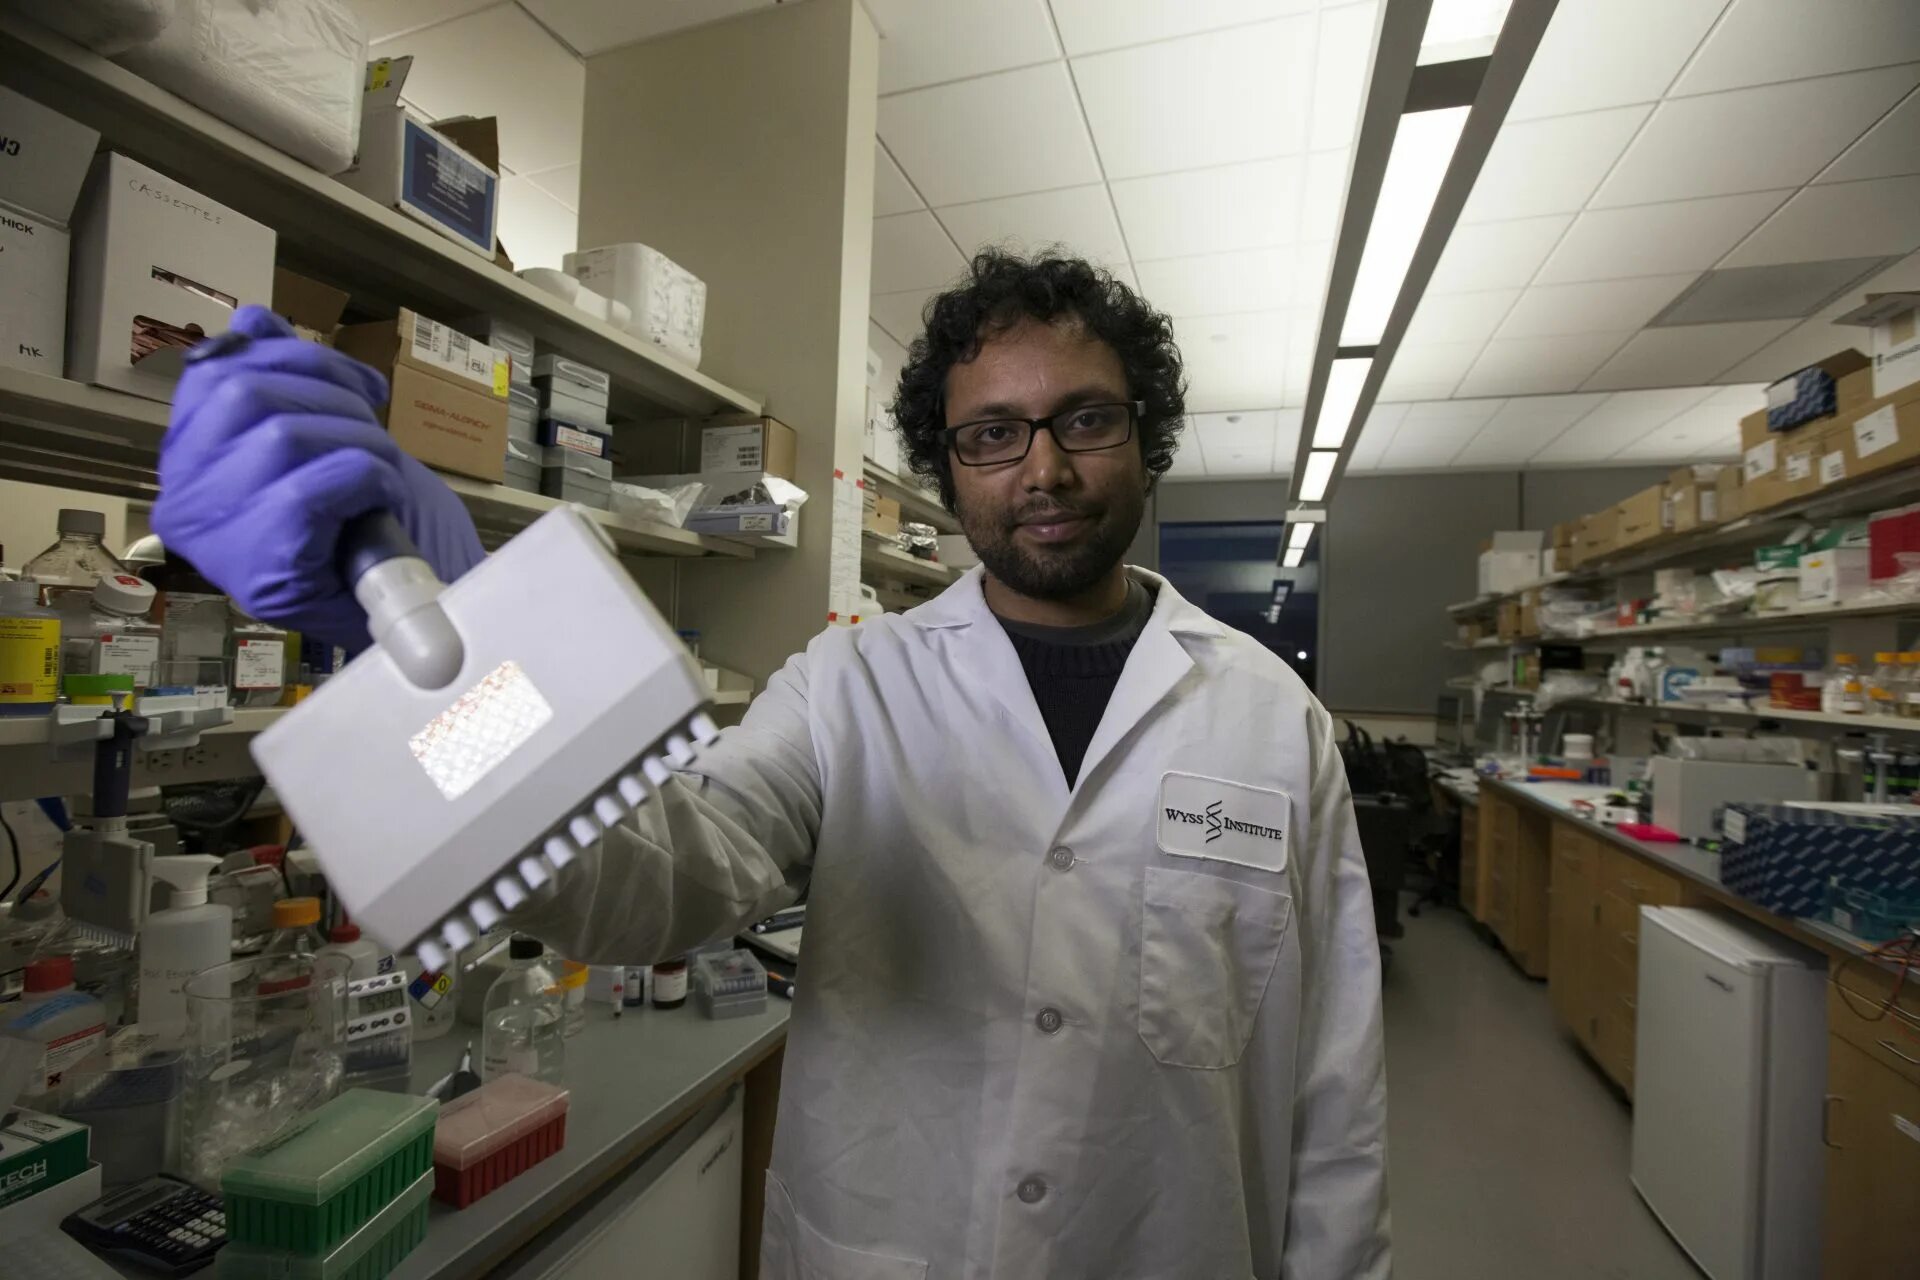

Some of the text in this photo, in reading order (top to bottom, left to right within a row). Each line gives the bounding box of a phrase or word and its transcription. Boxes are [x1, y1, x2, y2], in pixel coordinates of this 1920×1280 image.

[128, 179, 222, 224] CASSETTES
[0, 216, 33, 235] HICK
[1165, 808, 1283, 840] WYSS INSTITUTE
